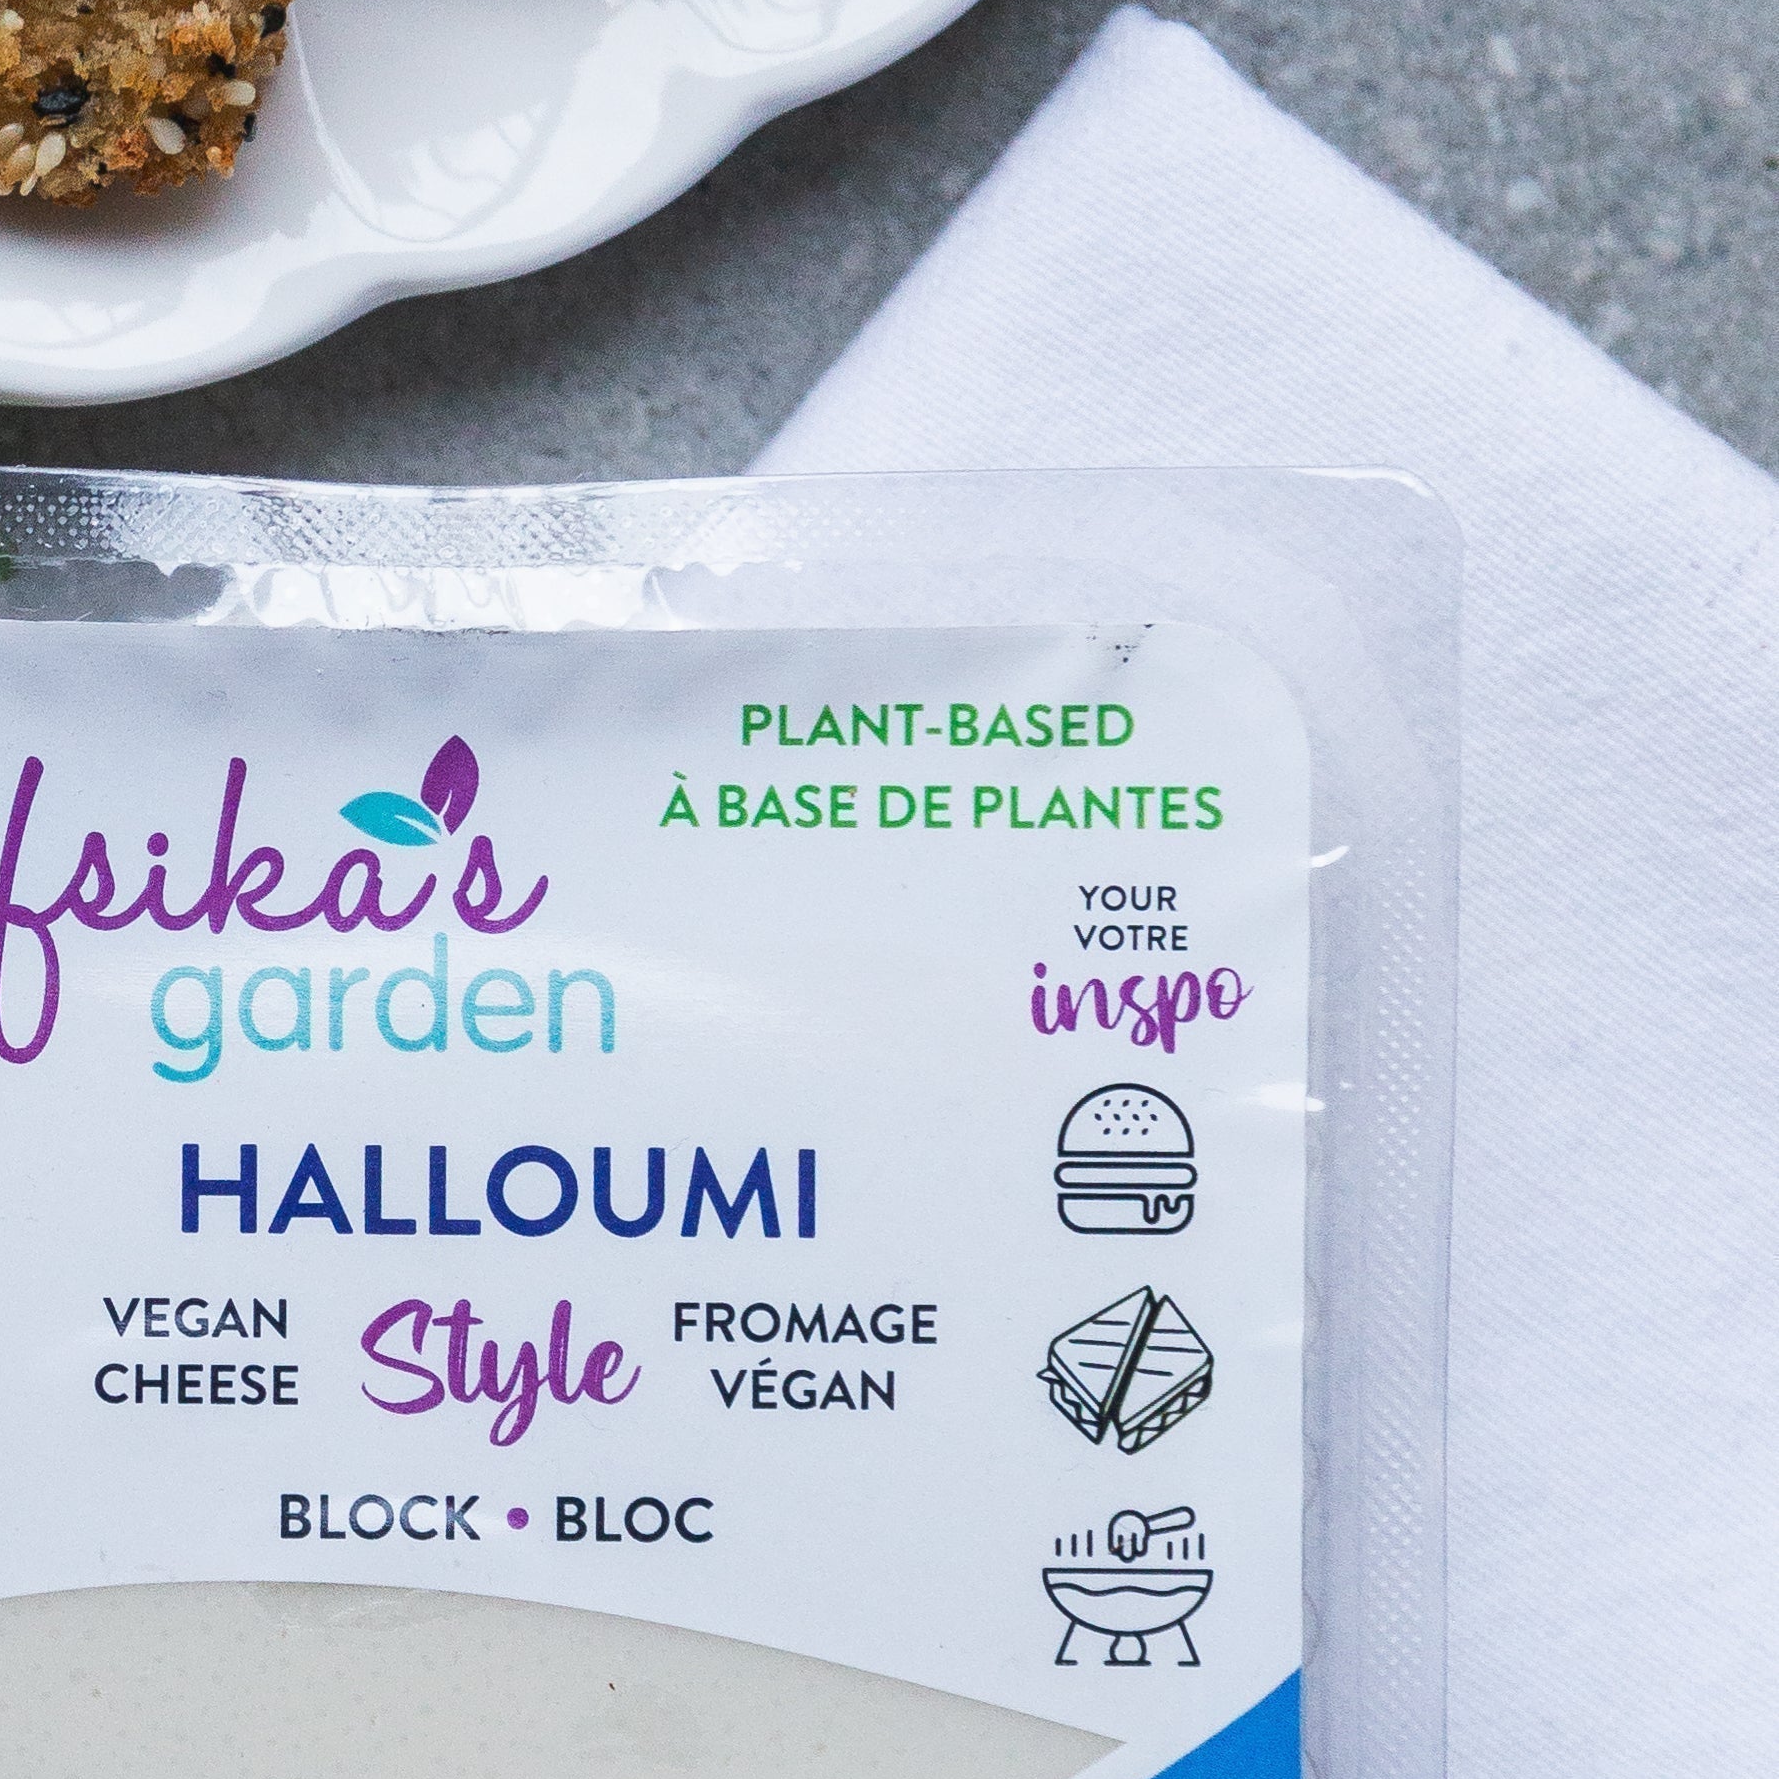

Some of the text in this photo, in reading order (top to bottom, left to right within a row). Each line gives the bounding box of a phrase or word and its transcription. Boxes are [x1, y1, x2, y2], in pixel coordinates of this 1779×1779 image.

[741, 703, 1135, 748] PLANT-BASED
[659, 771, 1223, 830] À BASE DE PLANTES
[1078, 885, 1178, 912] YOUR
[1074, 924, 1189, 952] VOTRE
[151, 932, 616, 1083] garden
[1031, 962, 1255, 1054] inspo
[180, 1143, 817, 1239] HALLOUMI
[103, 1297, 289, 1339] VEGAN
[674, 1301, 938, 1345] FROMAGE
[94, 1364, 300, 1406] CHEESE
[361, 1298, 642, 1447] Style
[711, 1358, 896, 1411] VÉGAN
[279, 1495, 715, 1544] BLOCK BLOC
